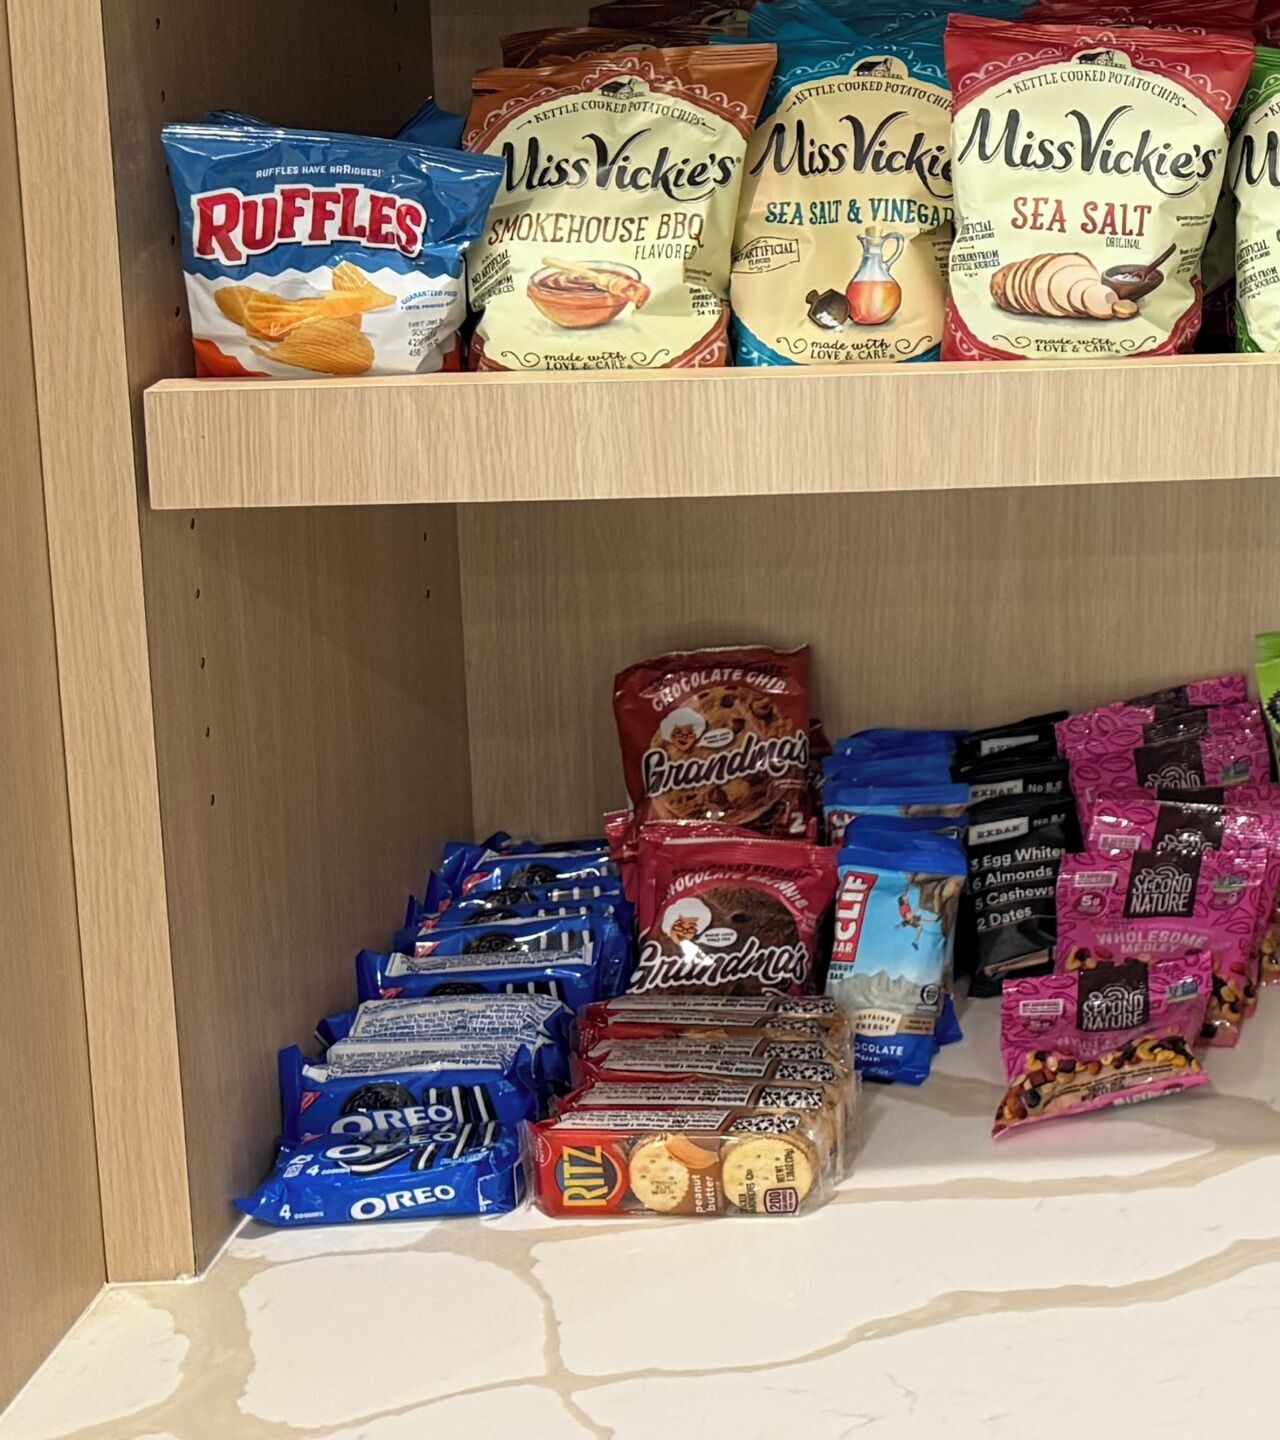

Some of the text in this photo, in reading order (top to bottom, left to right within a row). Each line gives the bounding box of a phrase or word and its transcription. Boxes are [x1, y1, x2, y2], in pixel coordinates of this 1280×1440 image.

[1013, 70, 1185, 107] KETTLE COOKED POTATO CHIPS
[957, 105, 1218, 199] Miss Vickie's
[195, 186, 424, 262] RUFFLES
[488, 212, 705, 248] SMOKEHOUSE BBQ
[1010, 196, 1153, 237] SEA SALT
[634, 243, 698, 262] FLAVORED
[641, 728, 809, 799] Grandma's
[1130, 891, 1191, 914] NATURE
[1132, 874, 1193, 896] SECOND
[834, 874, 870, 941] CLIF
[1082, 1010, 1144, 1032] NATURE
[562, 1144, 610, 1207] RITZ
[349, 1184, 457, 1222] OREO
